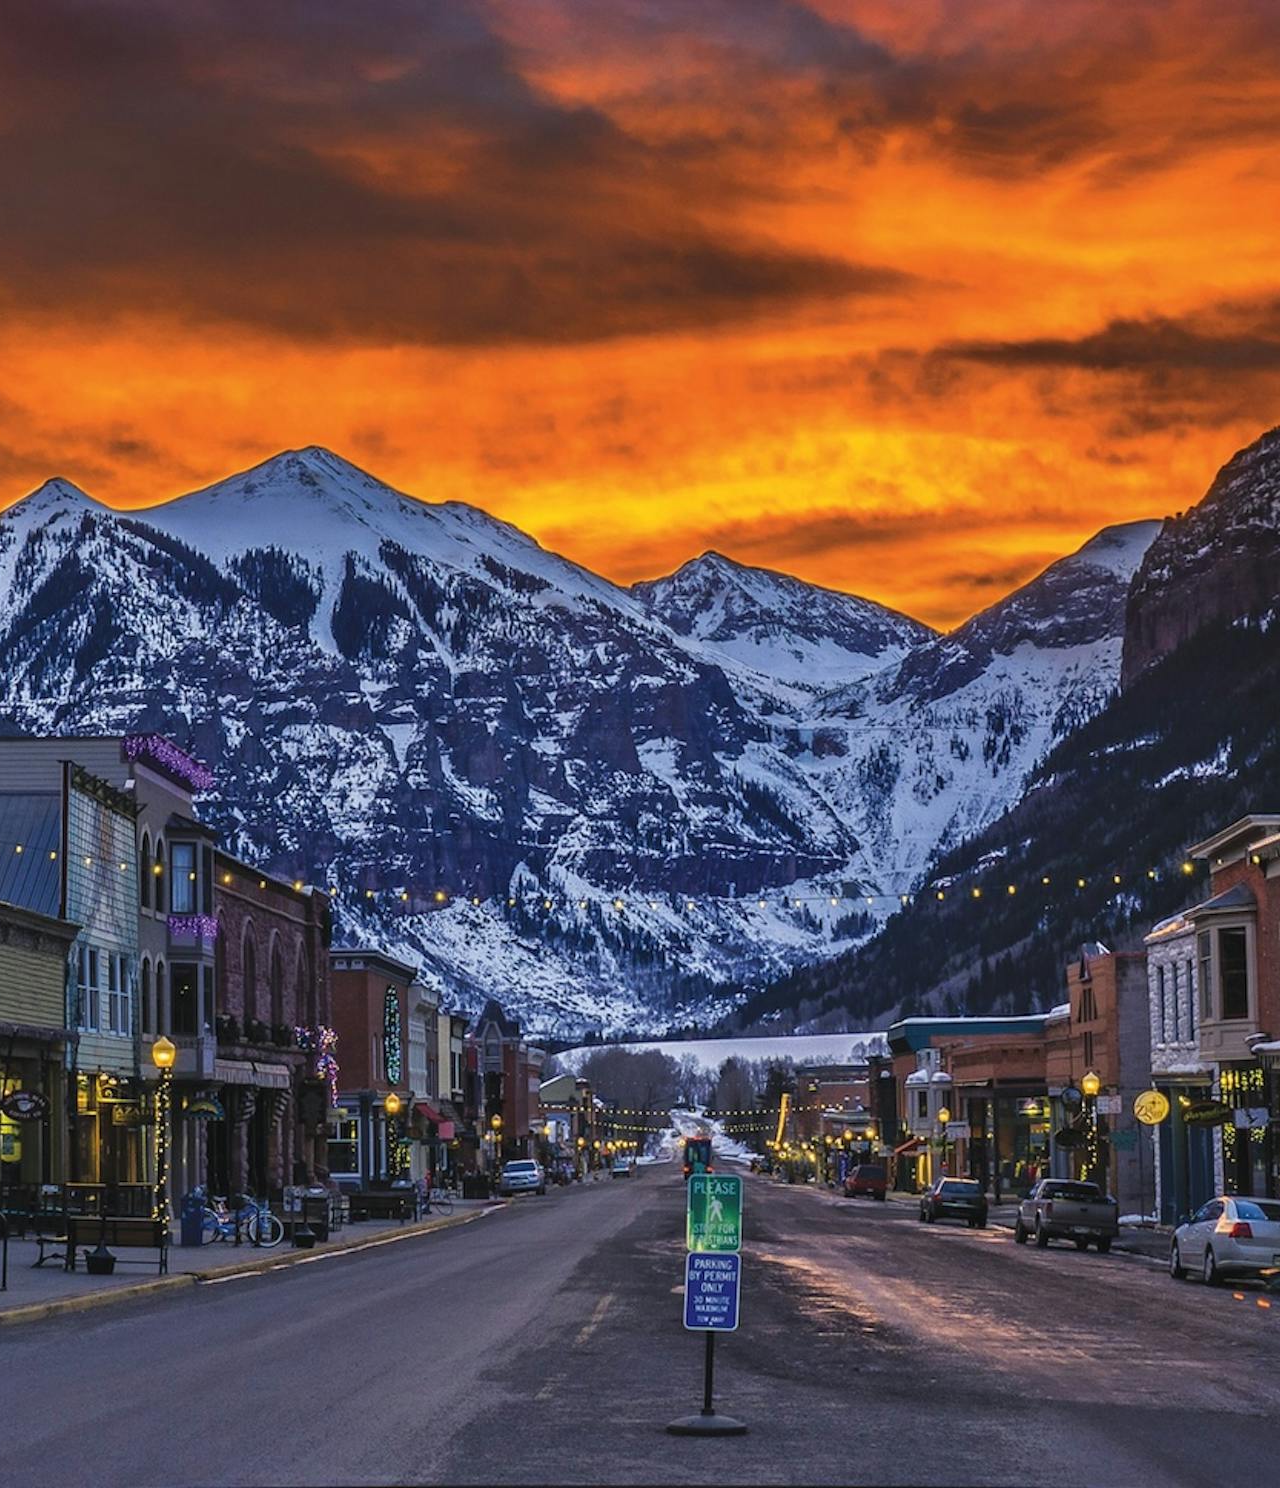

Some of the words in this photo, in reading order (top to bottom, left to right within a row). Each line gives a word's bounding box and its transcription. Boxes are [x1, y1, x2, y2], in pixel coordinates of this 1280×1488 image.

[693, 1181, 737, 1196] PLEASE
[693, 1222, 716, 1234] STOP
[717, 1222, 736, 1235] FOR
[690, 1233, 738, 1246] DESTRIANS
[694, 1258, 733, 1271] PARKING
[688, 1269, 702, 1281] BY
[703, 1270, 737, 1282] PERMIT
[700, 1281, 724, 1293] ONLY
[705, 1295, 731, 1306] MINUTE
[694, 1304, 729, 1314] MAXIMUM
